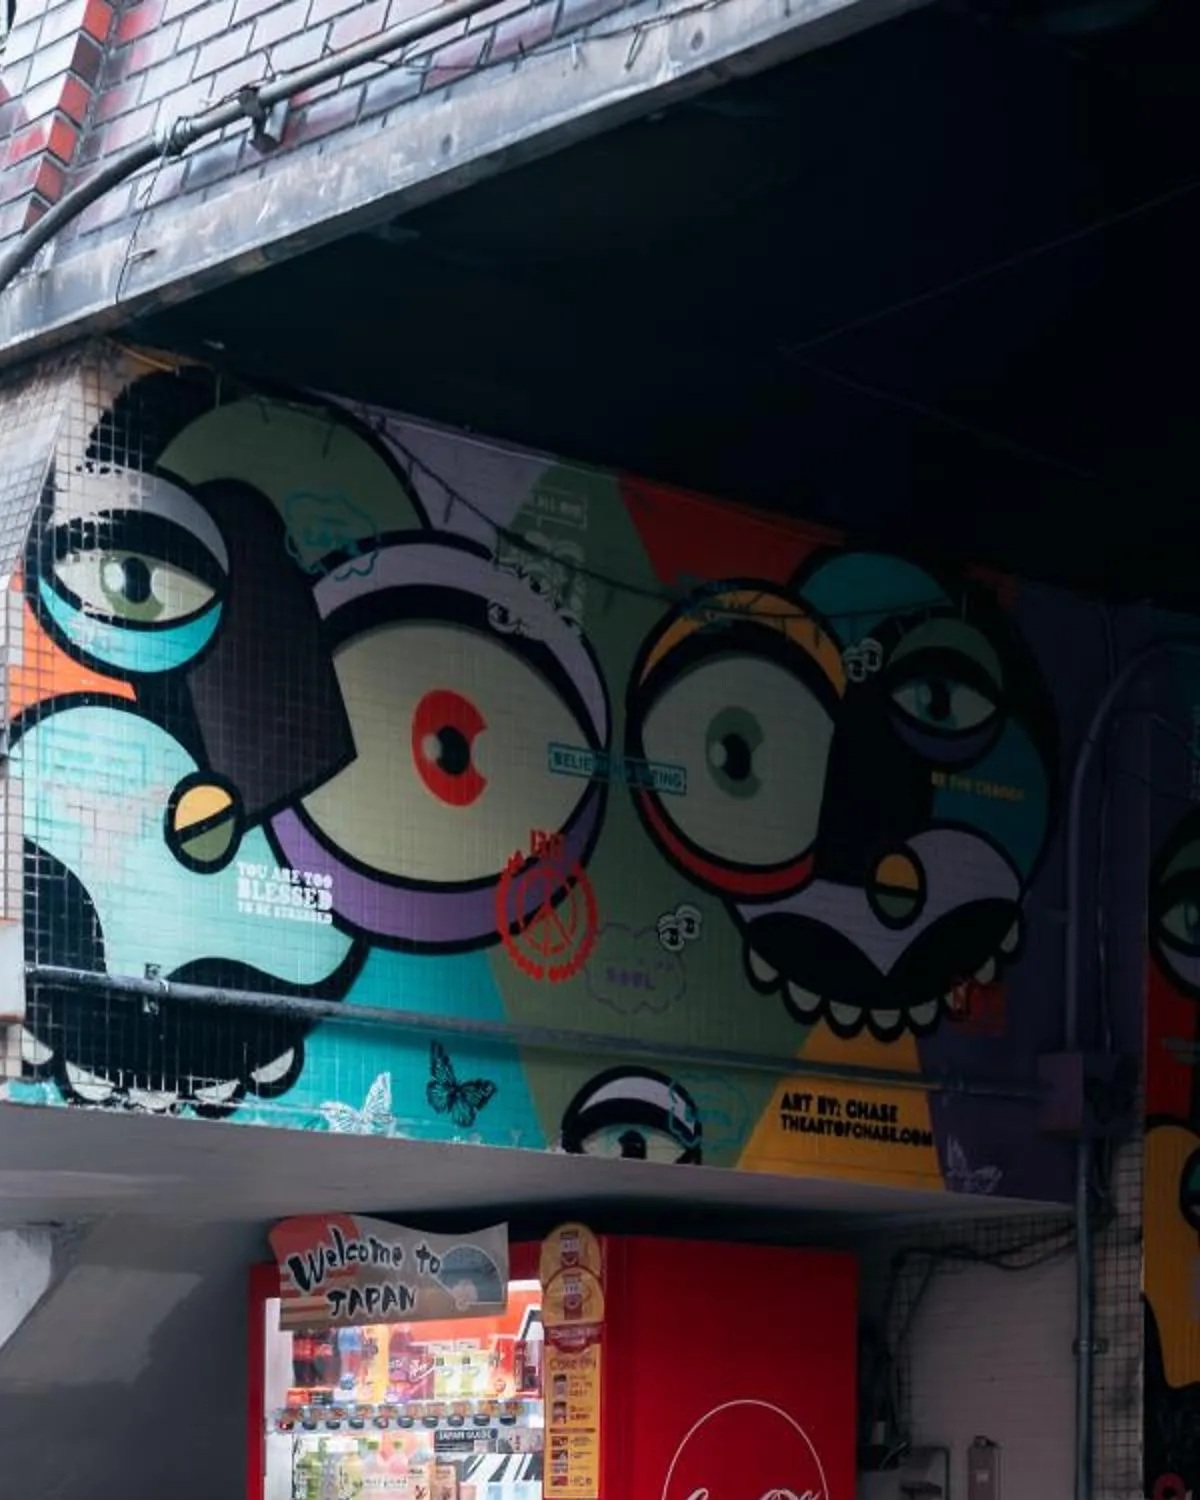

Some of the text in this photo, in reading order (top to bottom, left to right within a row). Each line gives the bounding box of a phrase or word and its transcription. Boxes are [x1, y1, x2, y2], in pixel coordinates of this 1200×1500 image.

[237, 862, 334, 889] YOU ARE TOO
[237, 877, 333, 911] BLESSED
[781, 1092, 898, 1123] ART BY: CHASE
[781, 1114, 933, 1147] THEARTOFCHASE.COM
[288, 1227, 441, 1292] Welcome to
[327, 1285, 416, 1317] JAPAN
